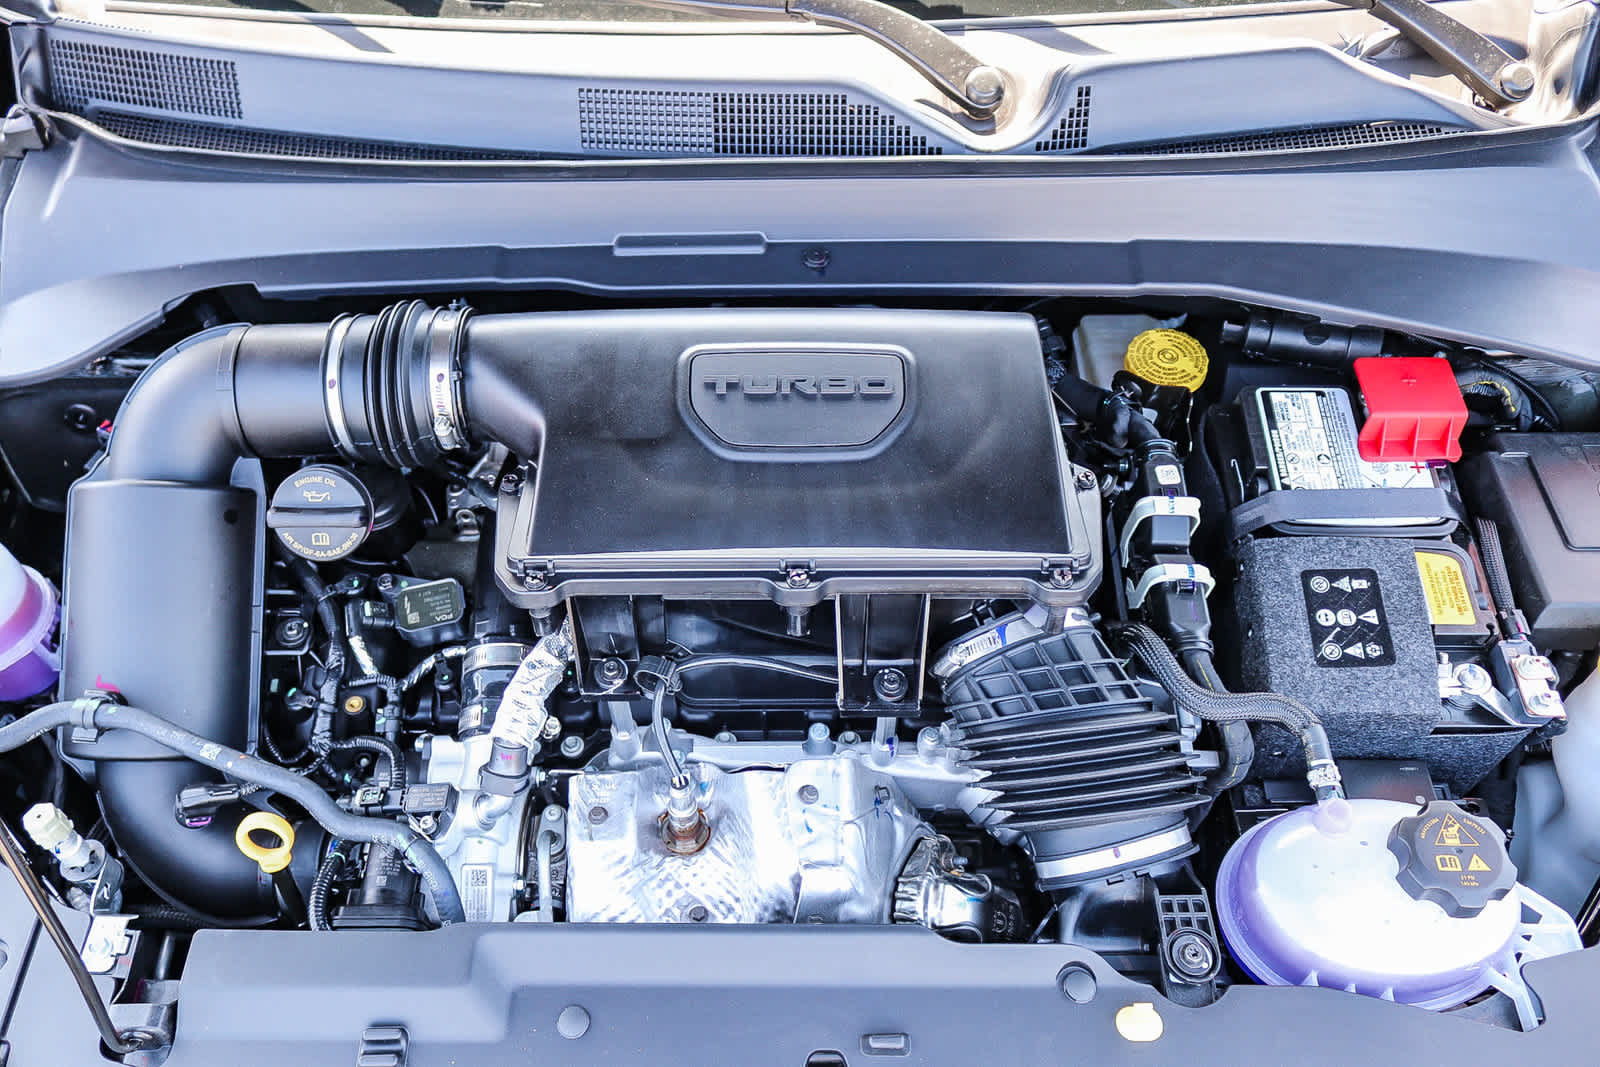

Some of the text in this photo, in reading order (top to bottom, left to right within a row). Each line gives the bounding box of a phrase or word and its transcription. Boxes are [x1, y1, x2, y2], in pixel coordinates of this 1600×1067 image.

[703, 375, 894, 398] TURBO
[294, 476, 337, 488] ENGINE OIL
